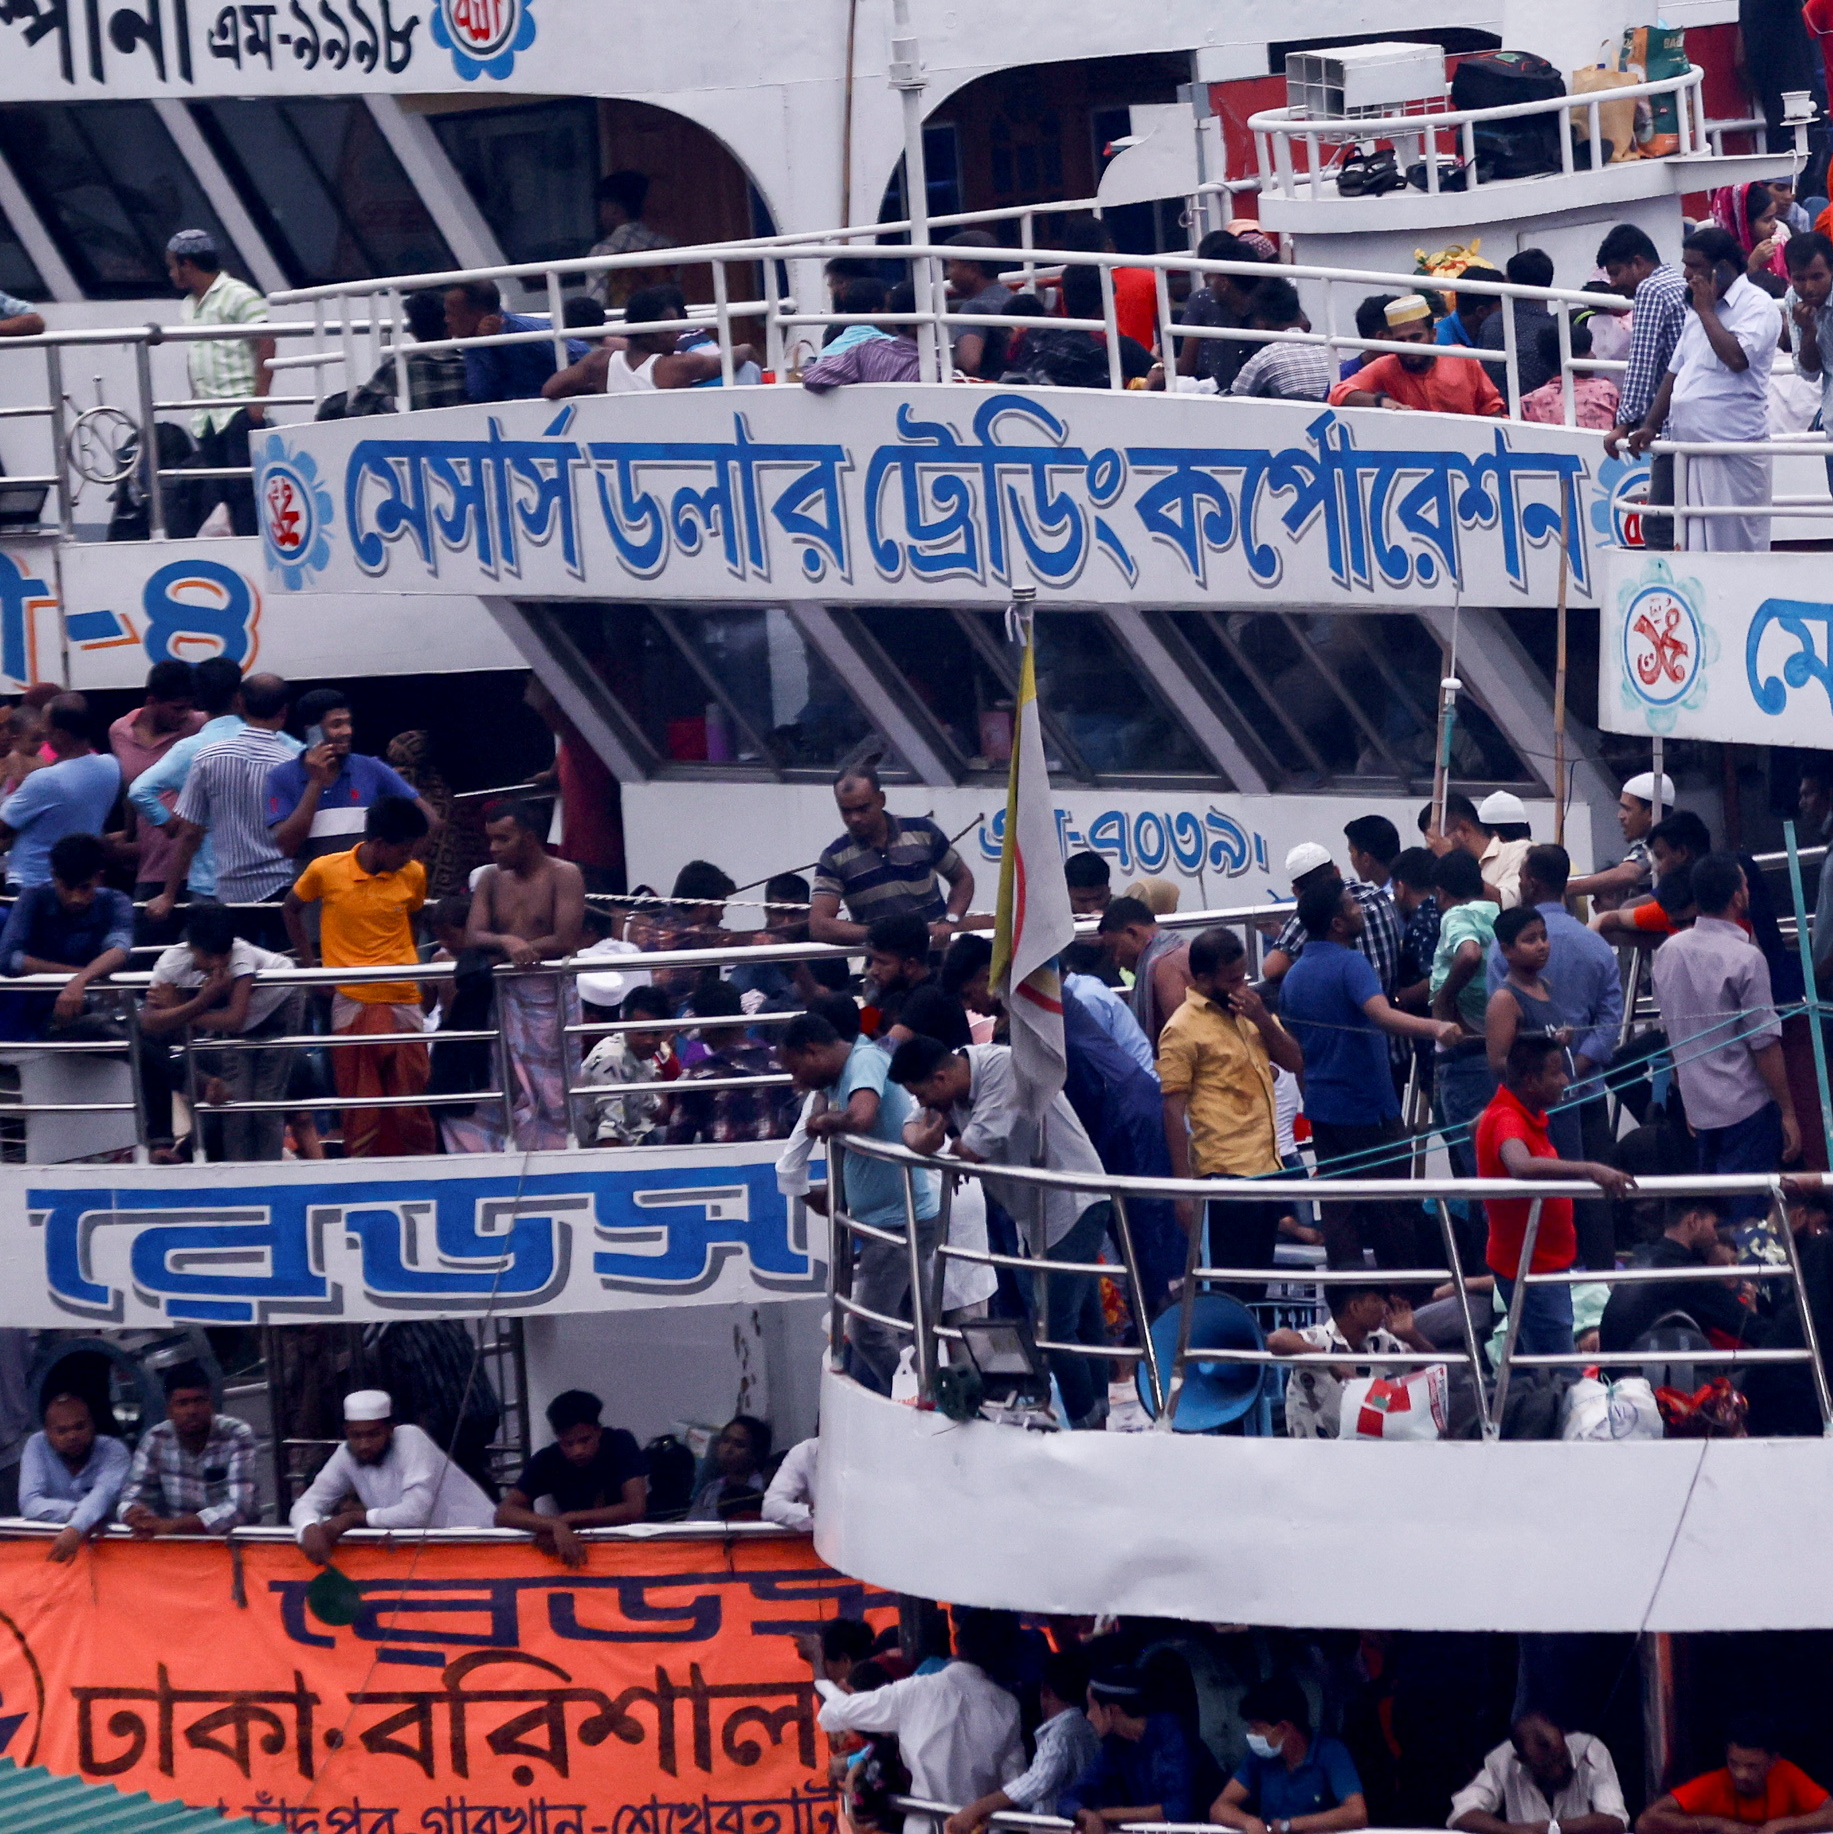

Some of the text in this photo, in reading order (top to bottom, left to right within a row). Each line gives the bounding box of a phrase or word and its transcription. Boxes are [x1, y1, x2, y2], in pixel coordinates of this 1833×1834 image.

[345, 404, 583, 580] মেসার্স
[587, 411, 855, 584] ডলার
[25, 1159, 828, 1324] রেডস
